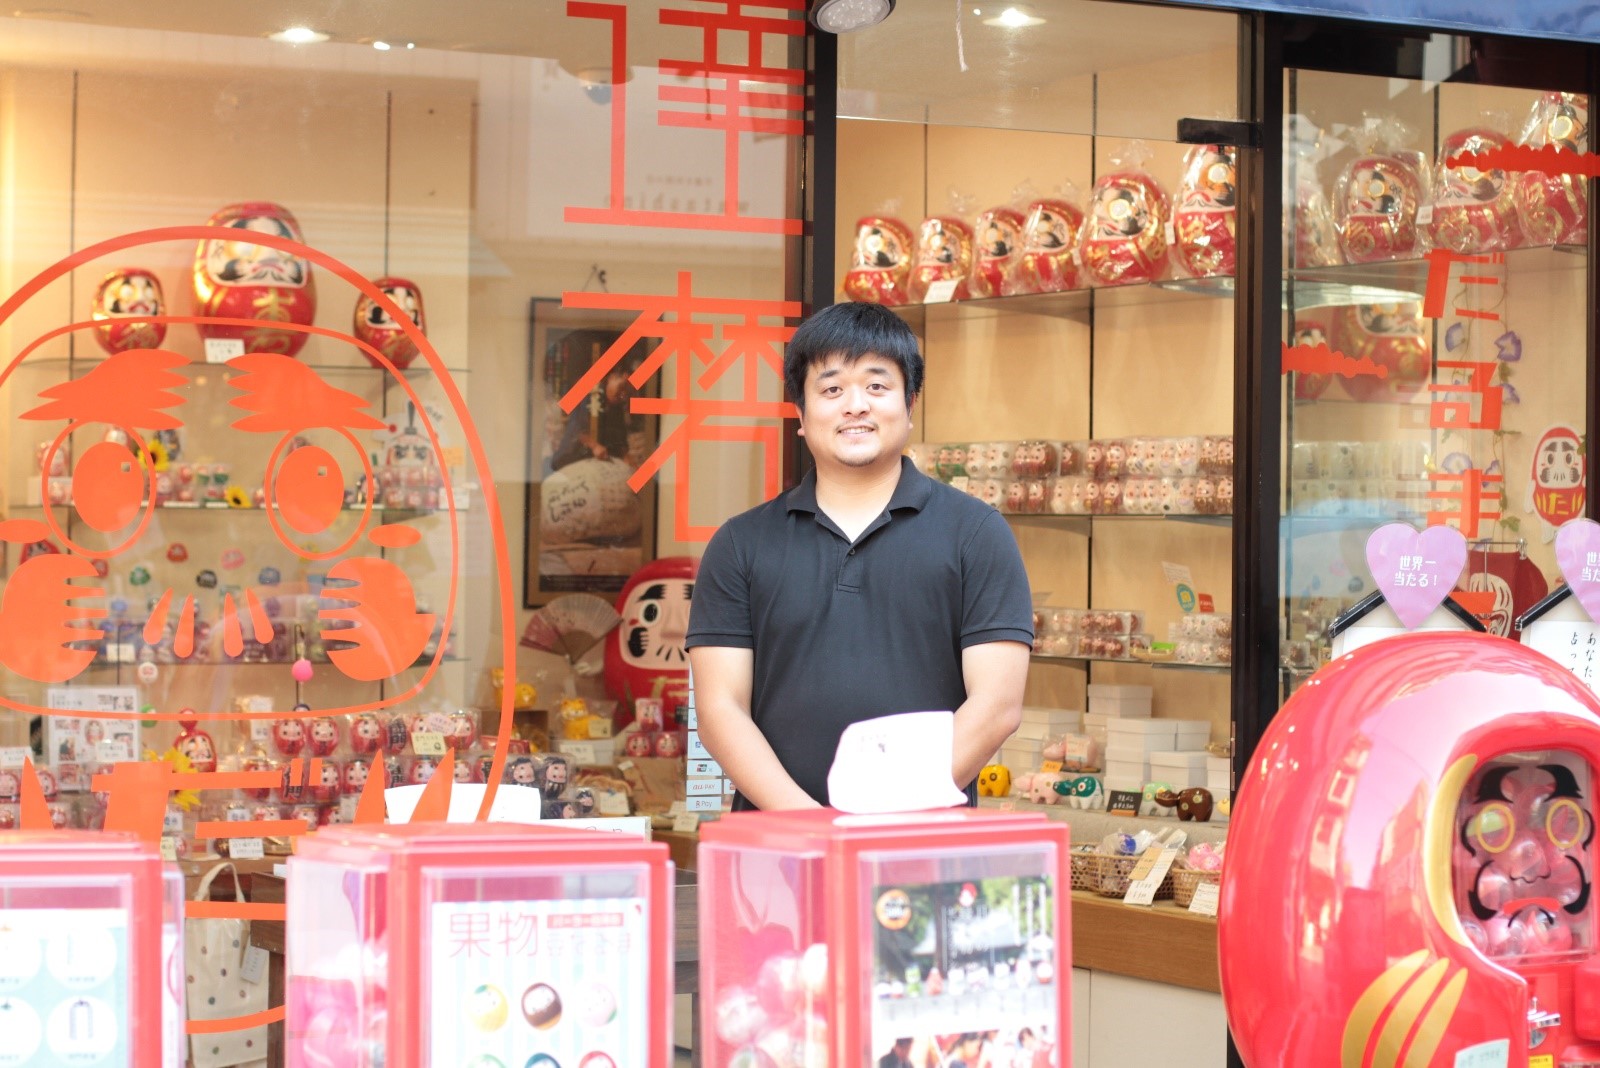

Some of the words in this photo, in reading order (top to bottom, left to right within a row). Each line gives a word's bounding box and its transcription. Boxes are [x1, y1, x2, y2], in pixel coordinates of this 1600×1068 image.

[1399, 555, 1436, 571] 世界一
[1587, 551, 1600, 566] 世
[449, 911, 538, 958] 果物
